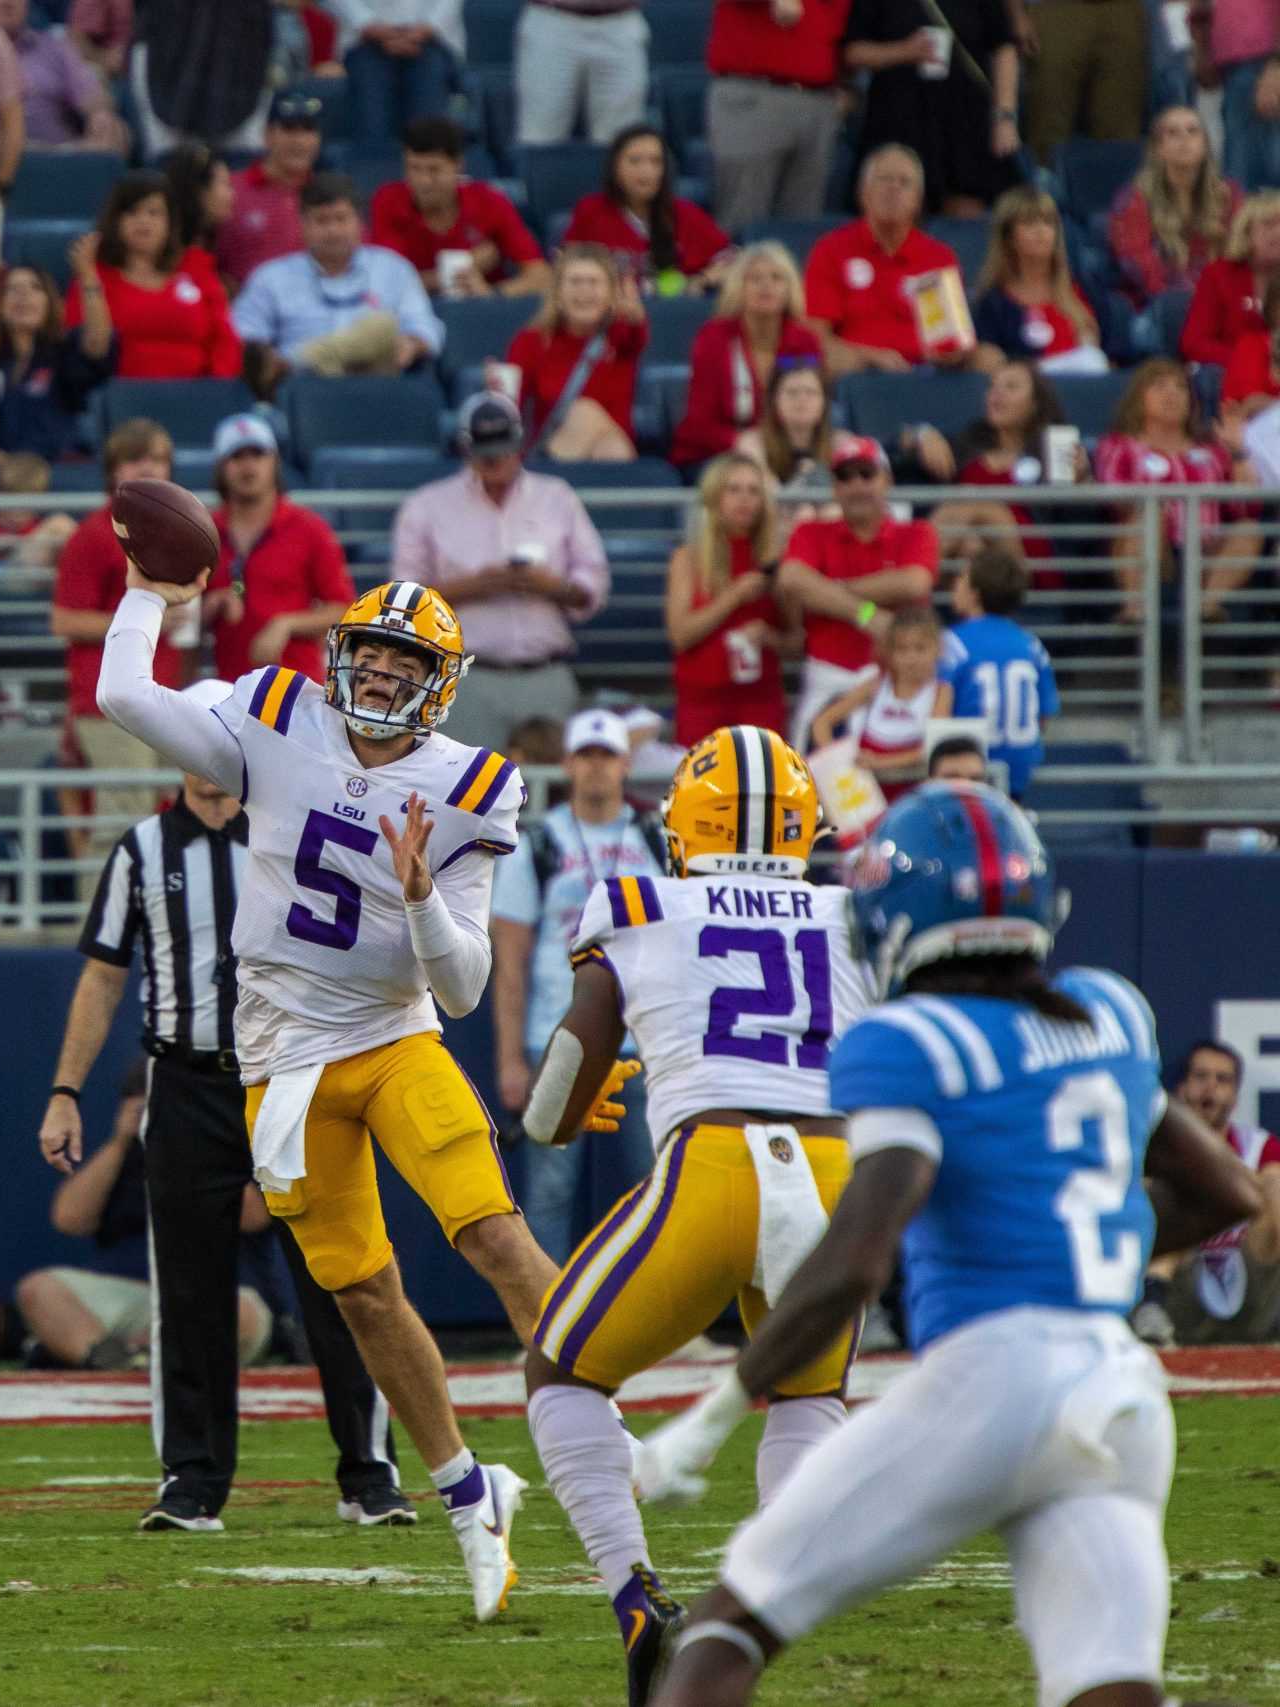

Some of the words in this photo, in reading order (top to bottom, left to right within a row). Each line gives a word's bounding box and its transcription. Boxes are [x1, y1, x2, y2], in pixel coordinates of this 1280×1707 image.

[975, 659, 1040, 745] 10
[348, 779, 367, 796] SEC
[333, 802, 366, 821] LSU
[167, 872, 183, 892] S
[286, 809, 380, 951] 5
[715, 859, 790, 872] TIGERS
[706, 886, 814, 919] KINER
[699, 924, 834, 1070] 21
[1047, 1069, 1141, 1303] 2
